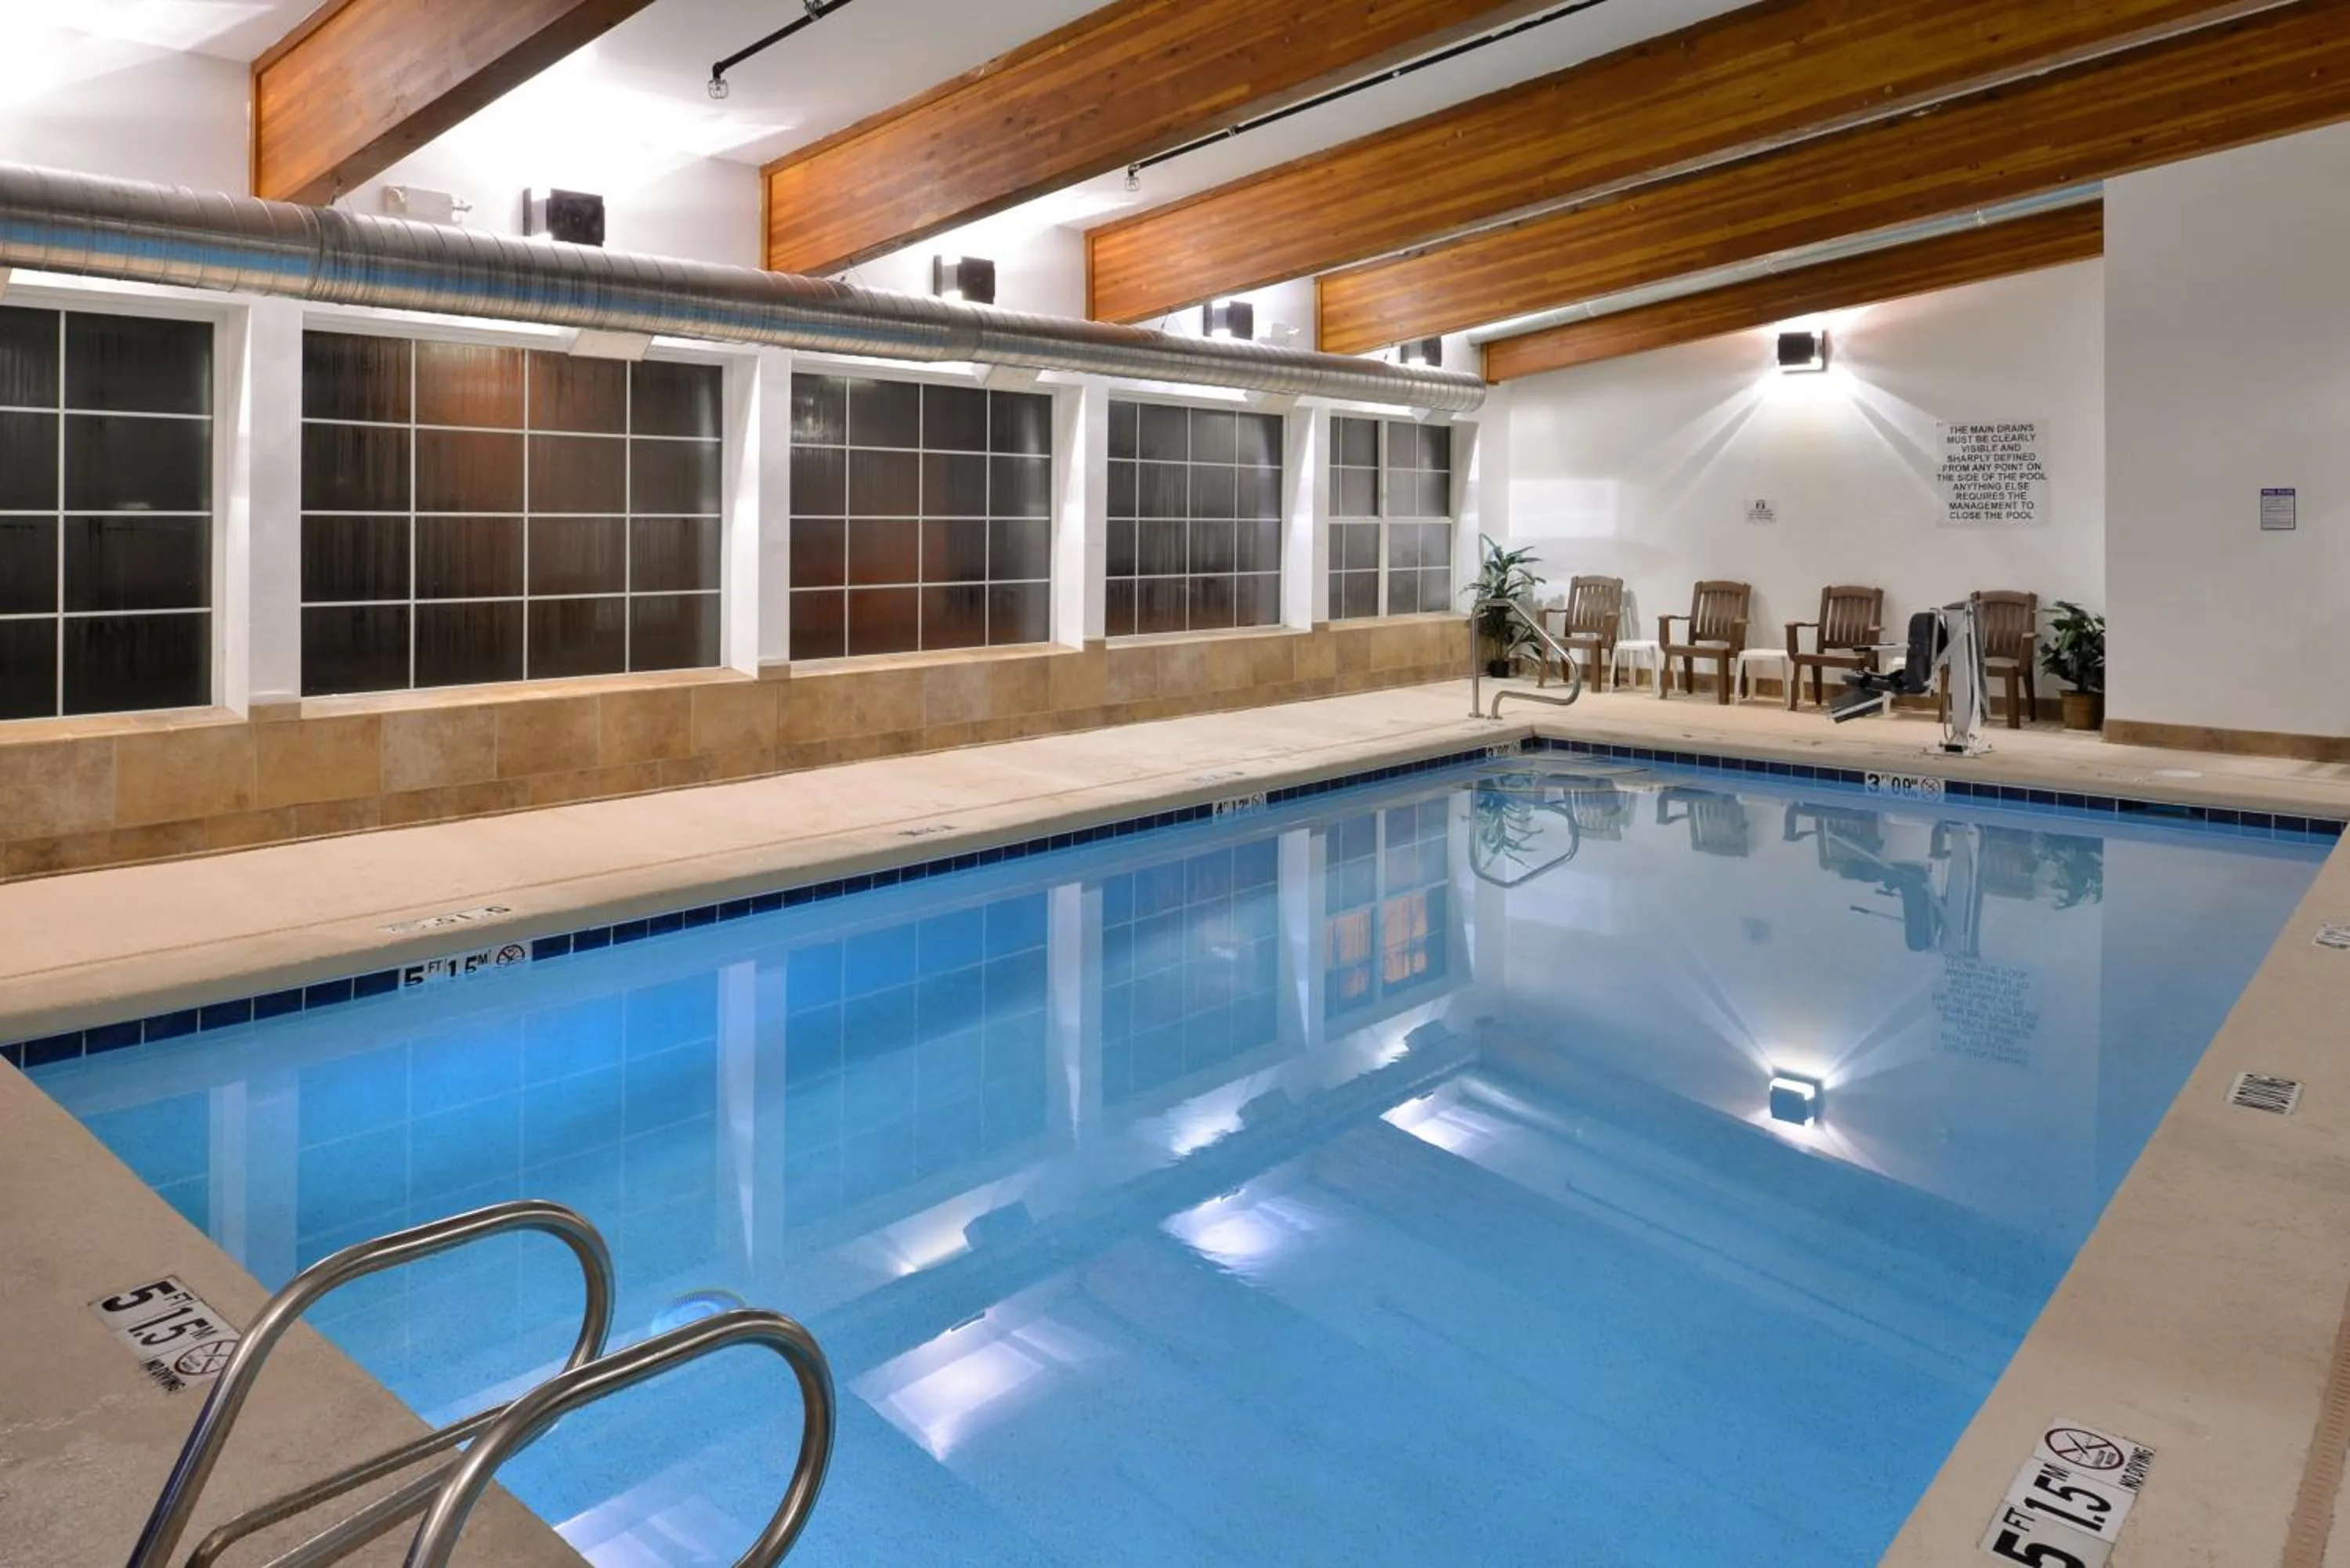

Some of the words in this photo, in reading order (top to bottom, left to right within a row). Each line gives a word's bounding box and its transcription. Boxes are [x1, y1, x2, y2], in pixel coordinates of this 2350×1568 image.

[1998, 424, 2034, 432] DRAINS
[1991, 434, 2035, 443] CLEARLY
[1994, 453, 2036, 461] DEFINED
[1943, 464, 1969, 472] FROM
[1953, 482, 2002, 491] ANYTHING
[2005, 482, 2030, 490] ELSE
[1955, 492, 2005, 500] REQUIRES
[1949, 501, 2018, 510] MANAGEMENT
